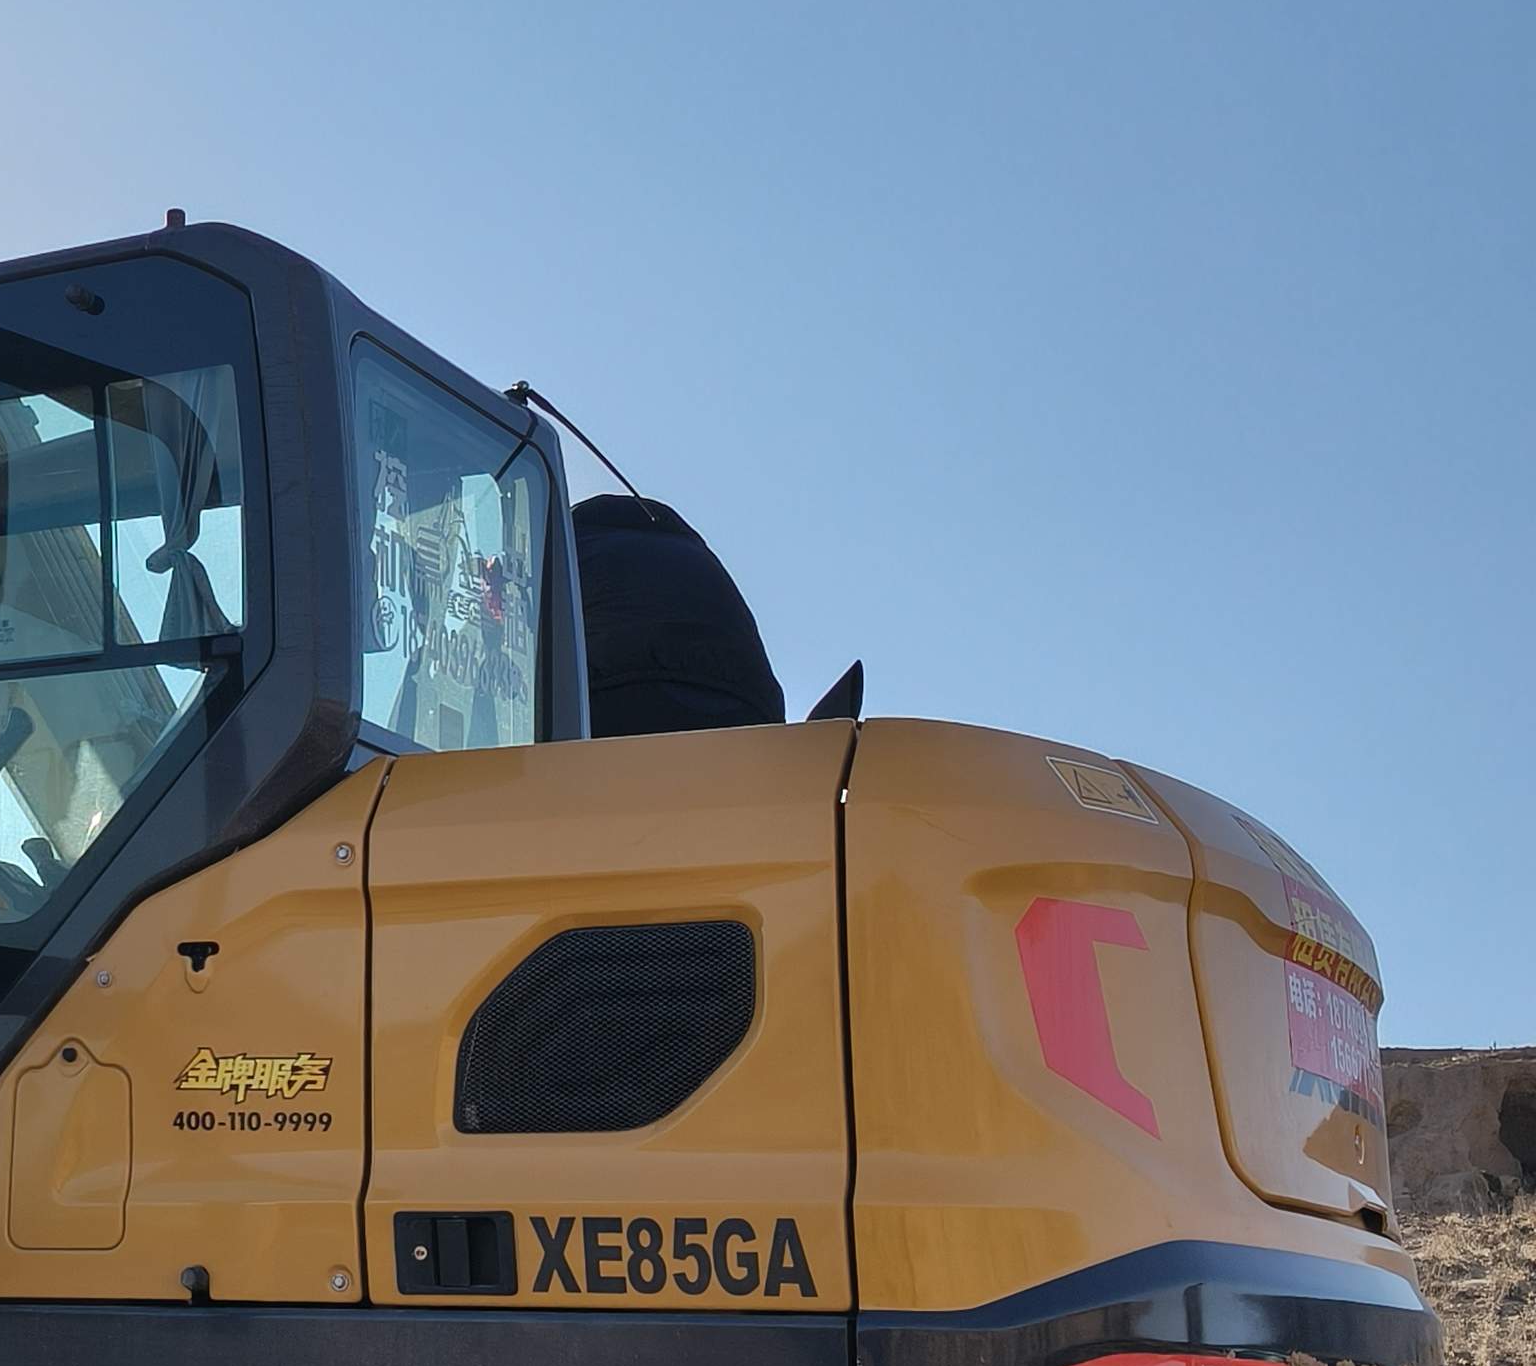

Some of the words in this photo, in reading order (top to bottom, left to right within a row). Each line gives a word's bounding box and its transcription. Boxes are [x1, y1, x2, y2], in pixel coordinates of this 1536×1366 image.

[173, 1047, 333, 1105] 金牌服务
[172, 1111, 332, 1132] 400-110-9999
[529, 1216, 818, 1298] XE85GA
